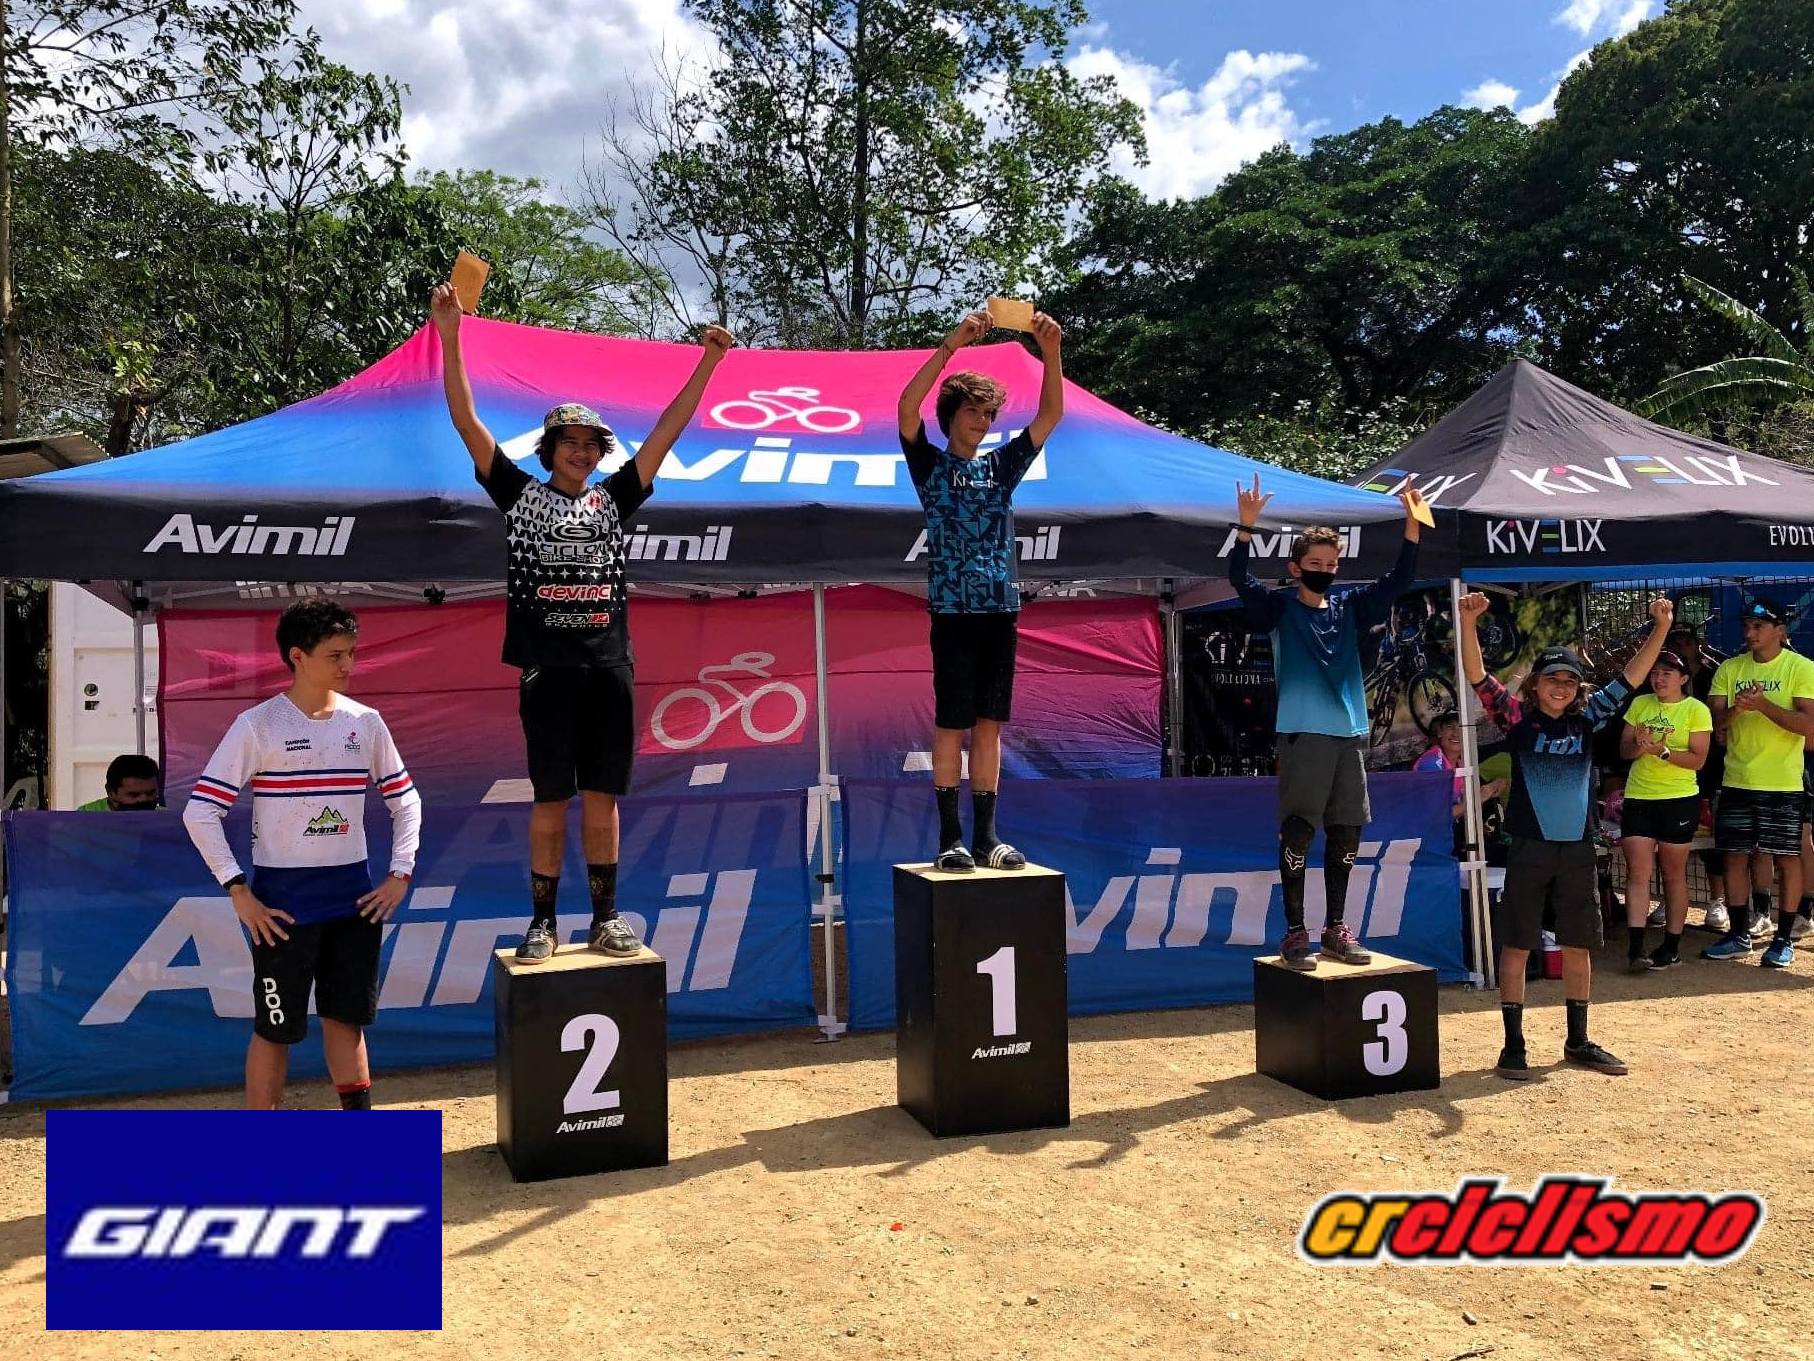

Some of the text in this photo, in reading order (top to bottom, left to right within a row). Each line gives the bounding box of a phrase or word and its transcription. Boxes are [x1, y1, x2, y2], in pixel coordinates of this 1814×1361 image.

[142, 513, 356, 556] Avimil
[303, 824, 339, 834] Avimil
[976, 946, 1017, 1037] 1
[971, 1043, 1016, 1060] Avimil
[1361, 990, 1408, 1077] 3
[560, 1013, 620, 1115] 2
[556, 1116, 608, 1134] Avimil
